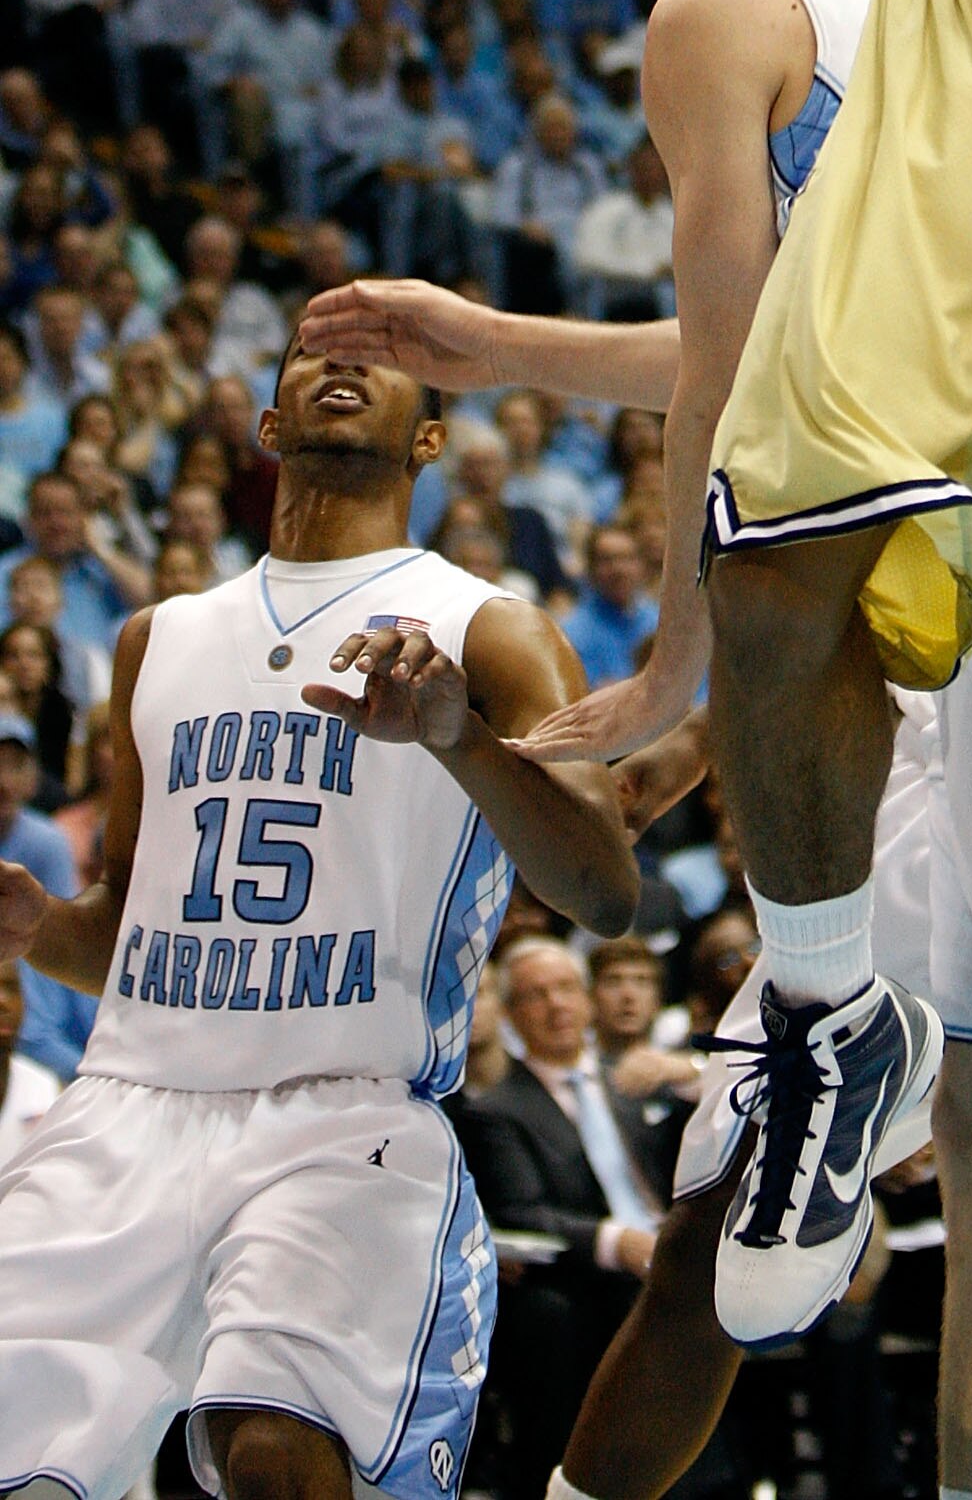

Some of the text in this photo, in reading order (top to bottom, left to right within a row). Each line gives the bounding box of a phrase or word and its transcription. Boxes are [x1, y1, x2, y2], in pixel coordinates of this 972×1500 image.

[168, 711, 360, 796] NORTH
[182, 797, 322, 925] 15
[118, 924, 377, 1012] CAROLINA
